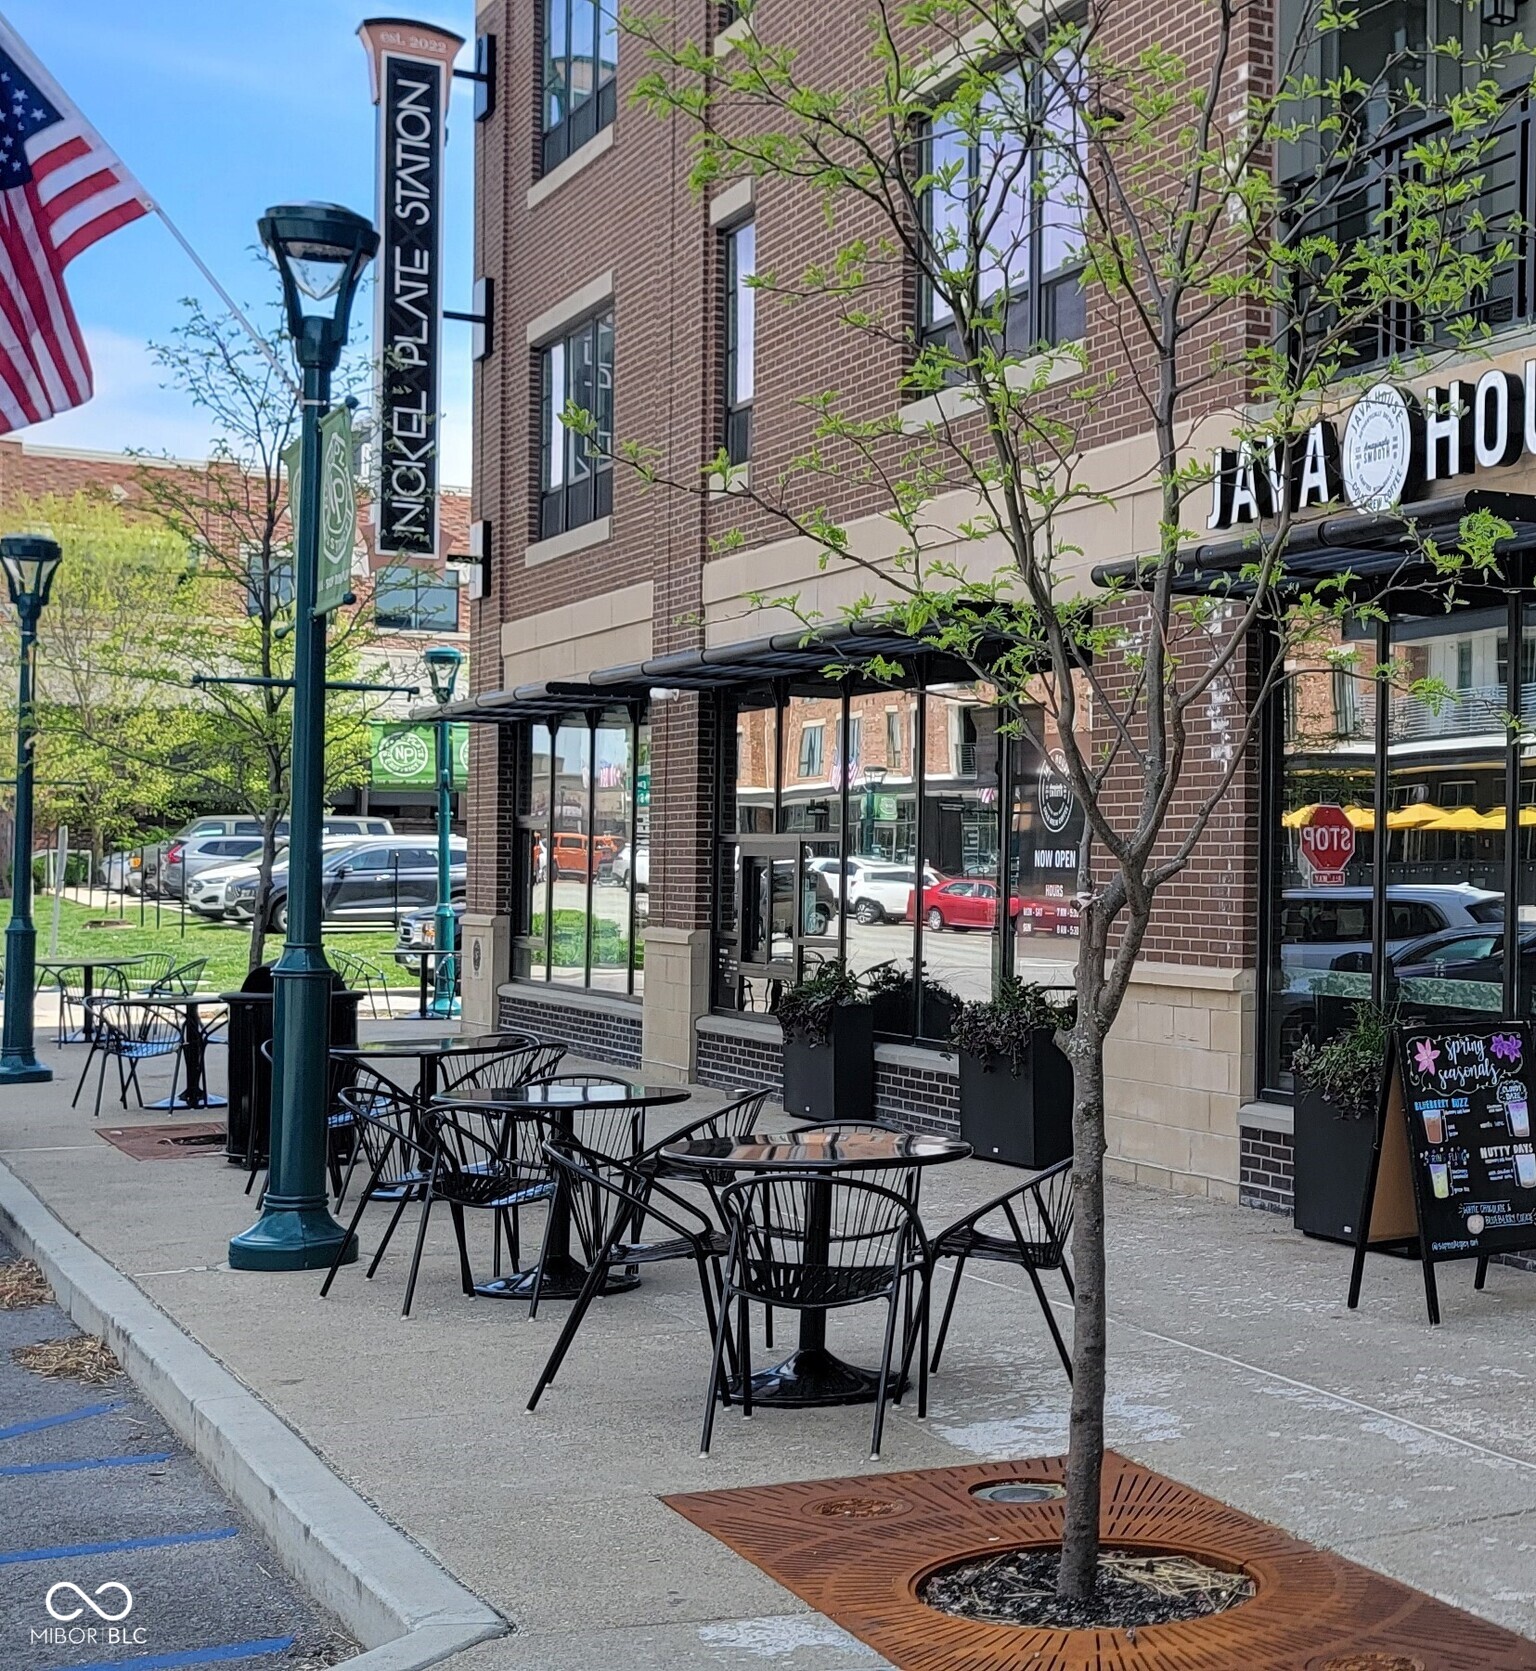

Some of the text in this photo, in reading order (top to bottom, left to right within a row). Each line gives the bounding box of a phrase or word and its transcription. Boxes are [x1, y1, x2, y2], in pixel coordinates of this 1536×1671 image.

[391, 78, 435, 533] NICKEL PLATE STATION
[1351, 390, 1404, 434] JAVA HOUSE
[1363, 445, 1391, 465] SMOOTH
[1207, 422, 1329, 530] JAVA
[1383, 468, 1403, 503] COFFEE
[394, 745, 414, 764] NP
[1034, 850, 1076, 869] NOW OPEN
[1045, 884, 1064, 898] HOURS
[1438, 1057, 1500, 1090] seasonals
[1451, 1097, 1470, 1108] BUZZ
[1479, 1142, 1534, 1160] NUTTY DAYS
[1484, 1213, 1516, 1225] BLUEBERRY
